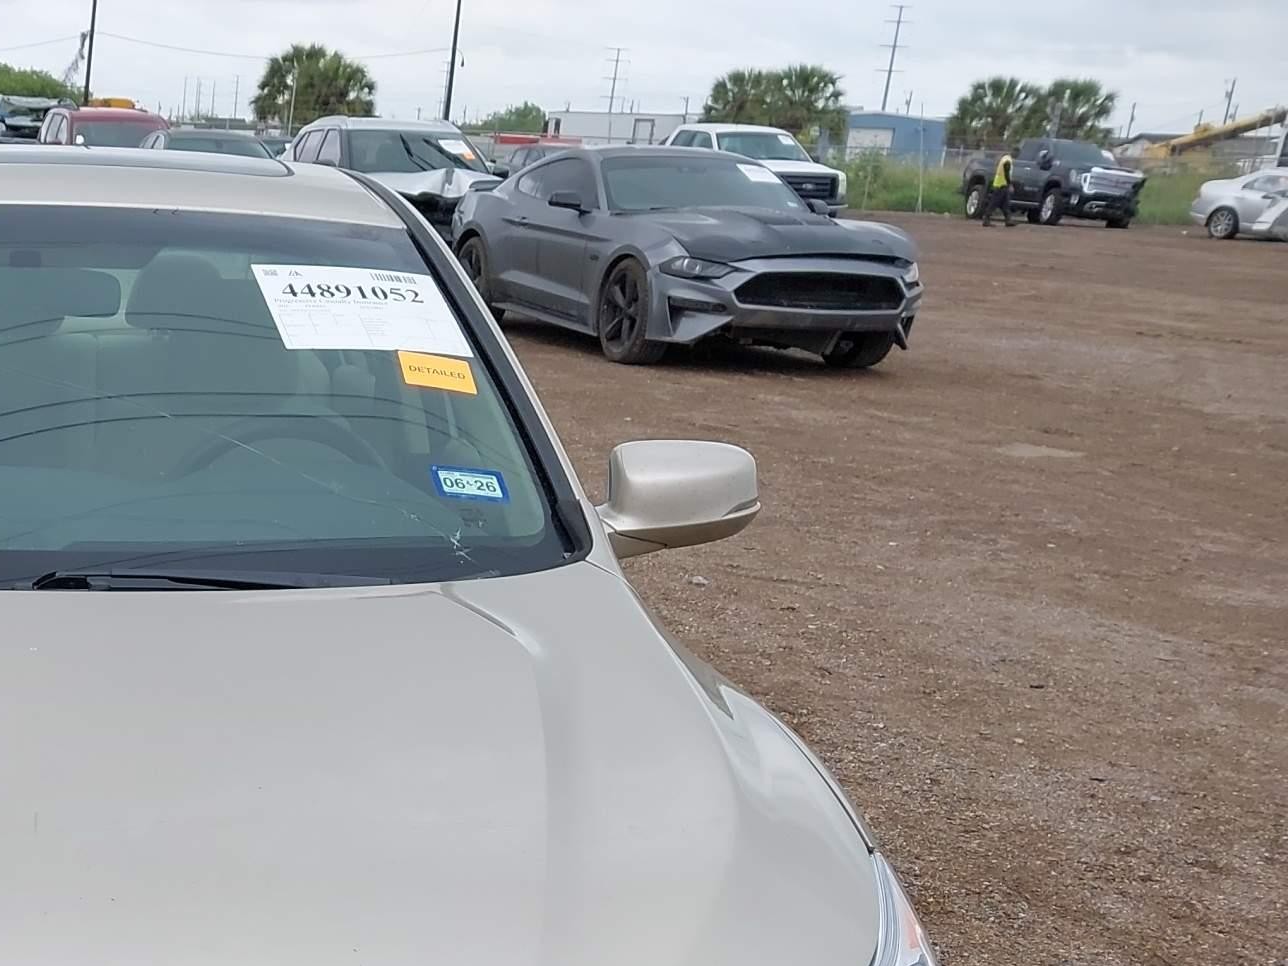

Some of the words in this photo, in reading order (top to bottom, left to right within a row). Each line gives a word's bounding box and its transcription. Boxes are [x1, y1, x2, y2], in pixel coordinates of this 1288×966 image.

[281, 282, 425, 304] 44891052
[408, 364, 466, 380] DETAILED
[442, 476, 466, 490] 06
[474, 479, 497, 493] 26
